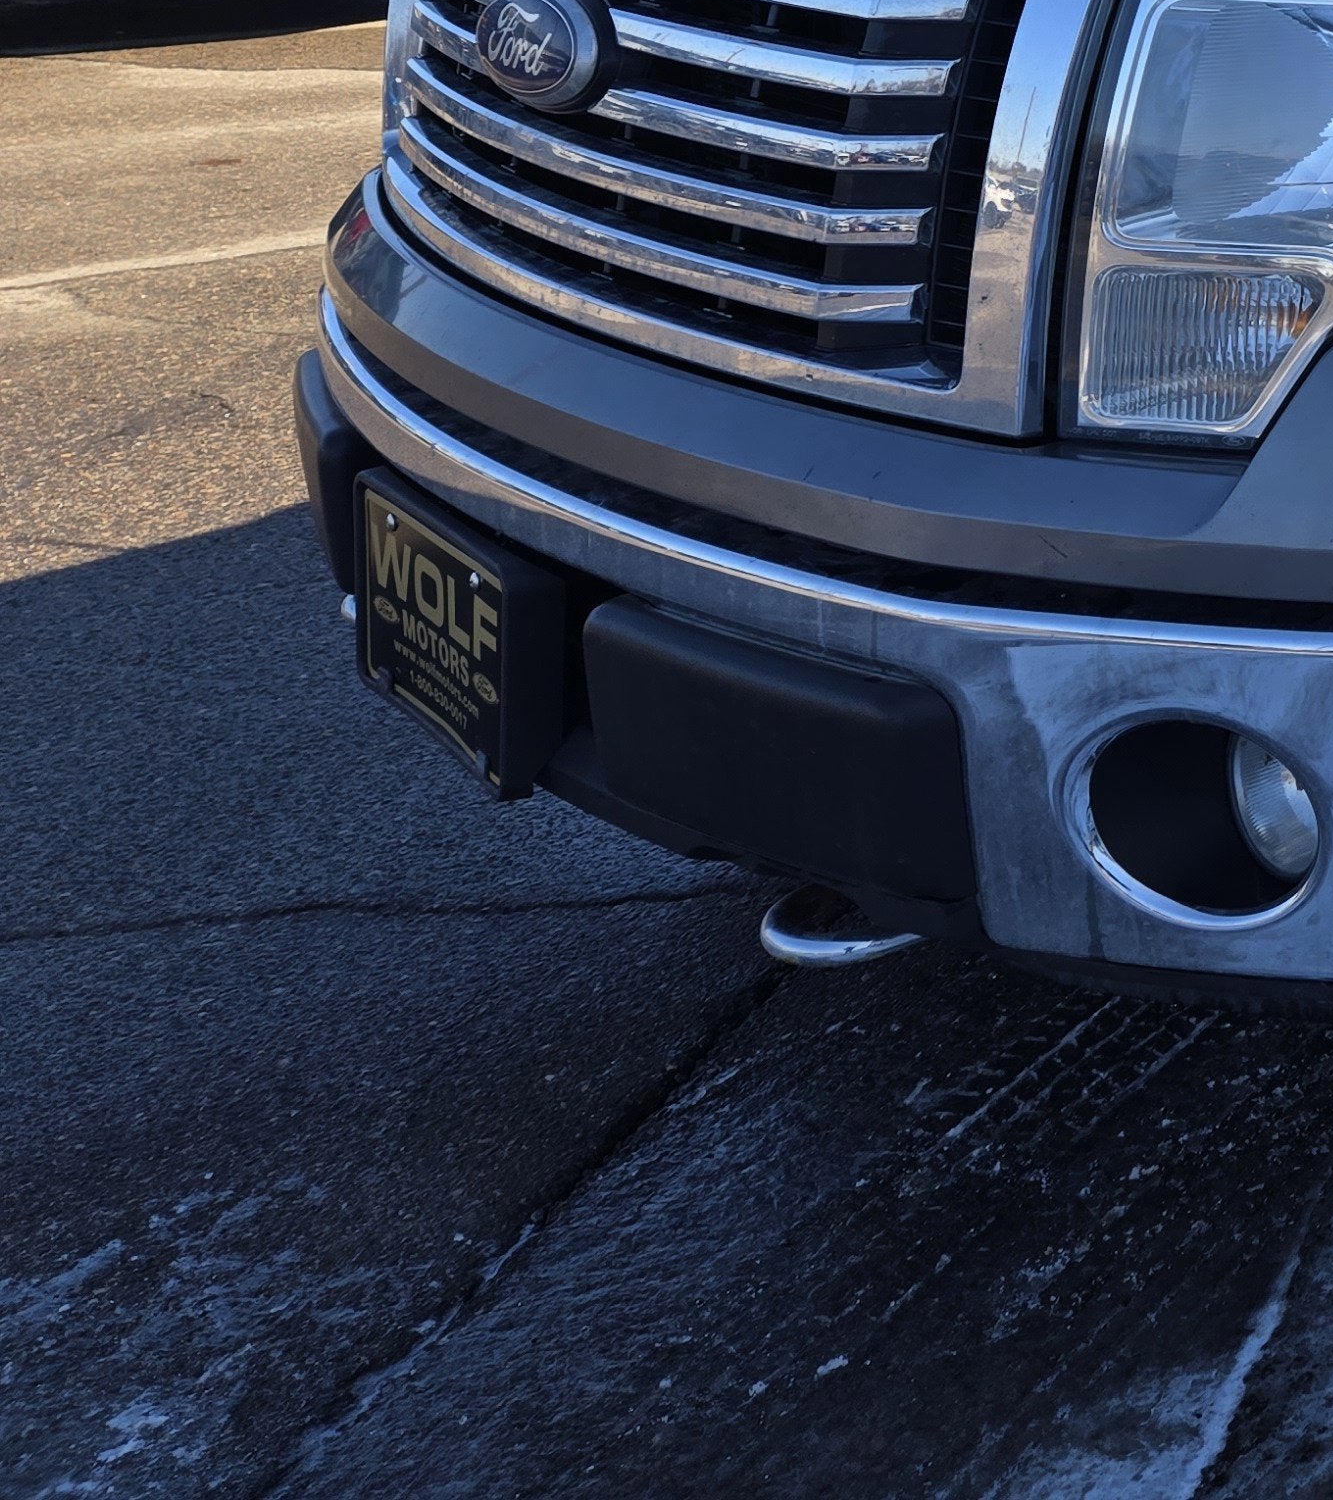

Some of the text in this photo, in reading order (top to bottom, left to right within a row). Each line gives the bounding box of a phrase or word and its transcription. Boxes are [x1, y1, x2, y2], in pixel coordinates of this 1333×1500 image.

[488, 2, 553, 76] Ford
[371, 522, 498, 662] WOLF
[402, 609, 470, 687] MOTORS
